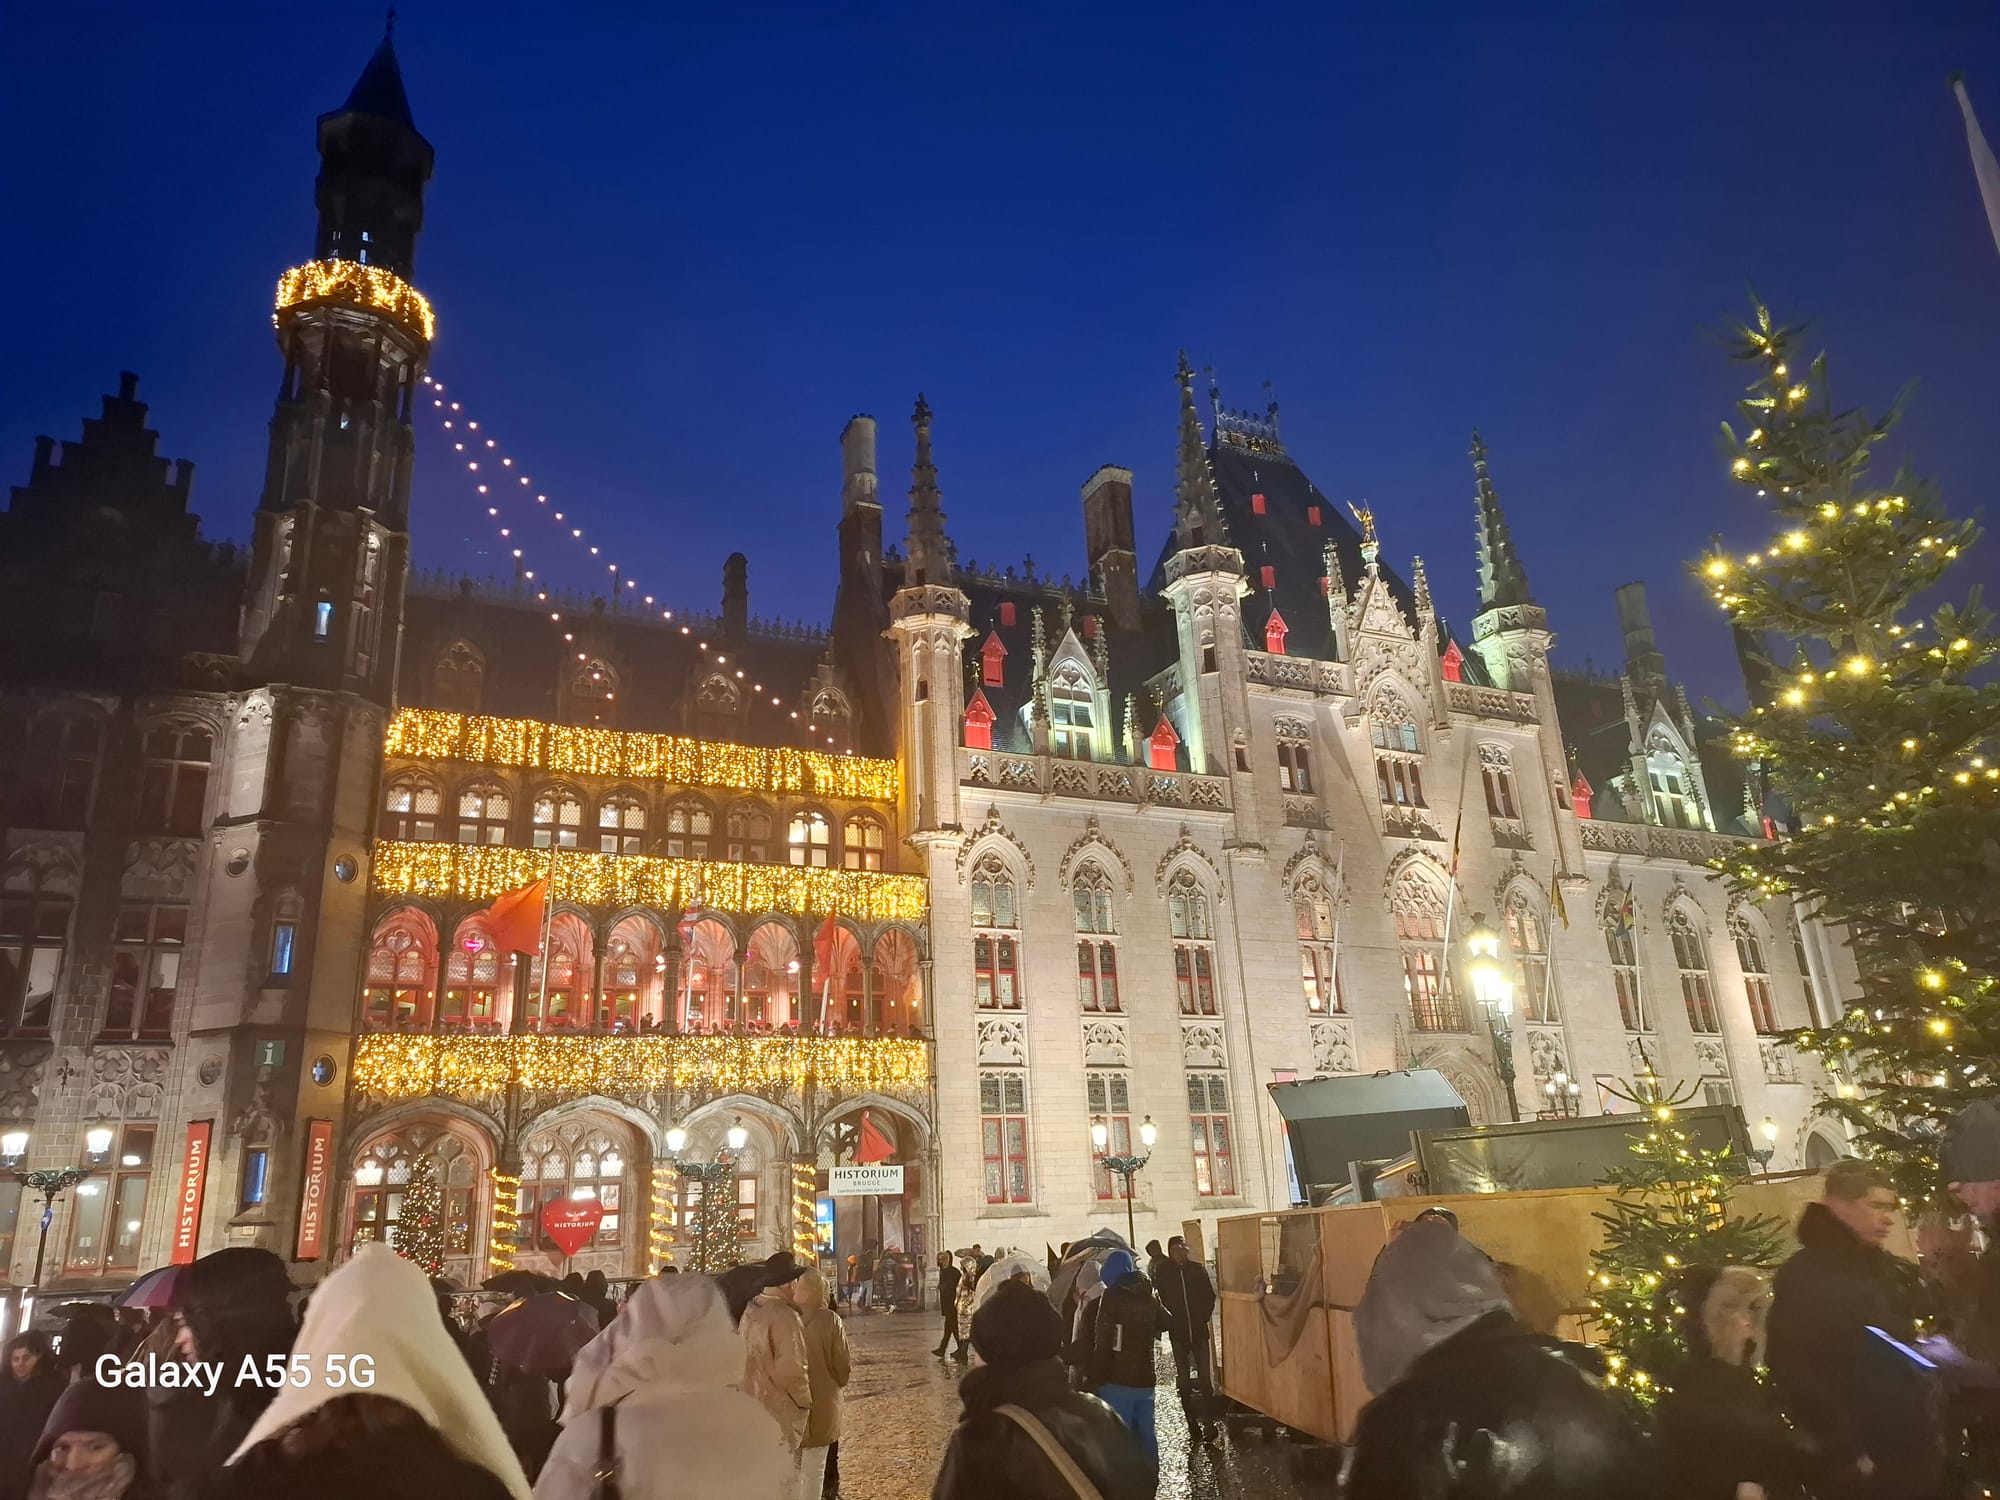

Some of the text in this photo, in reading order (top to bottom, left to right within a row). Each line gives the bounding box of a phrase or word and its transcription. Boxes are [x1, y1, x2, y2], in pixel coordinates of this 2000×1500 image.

[179, 1139, 202, 1248] HISTORIUM
[304, 1137, 325, 1242] HISTORIUM
[834, 1169, 899, 1180] HISTORIUM
